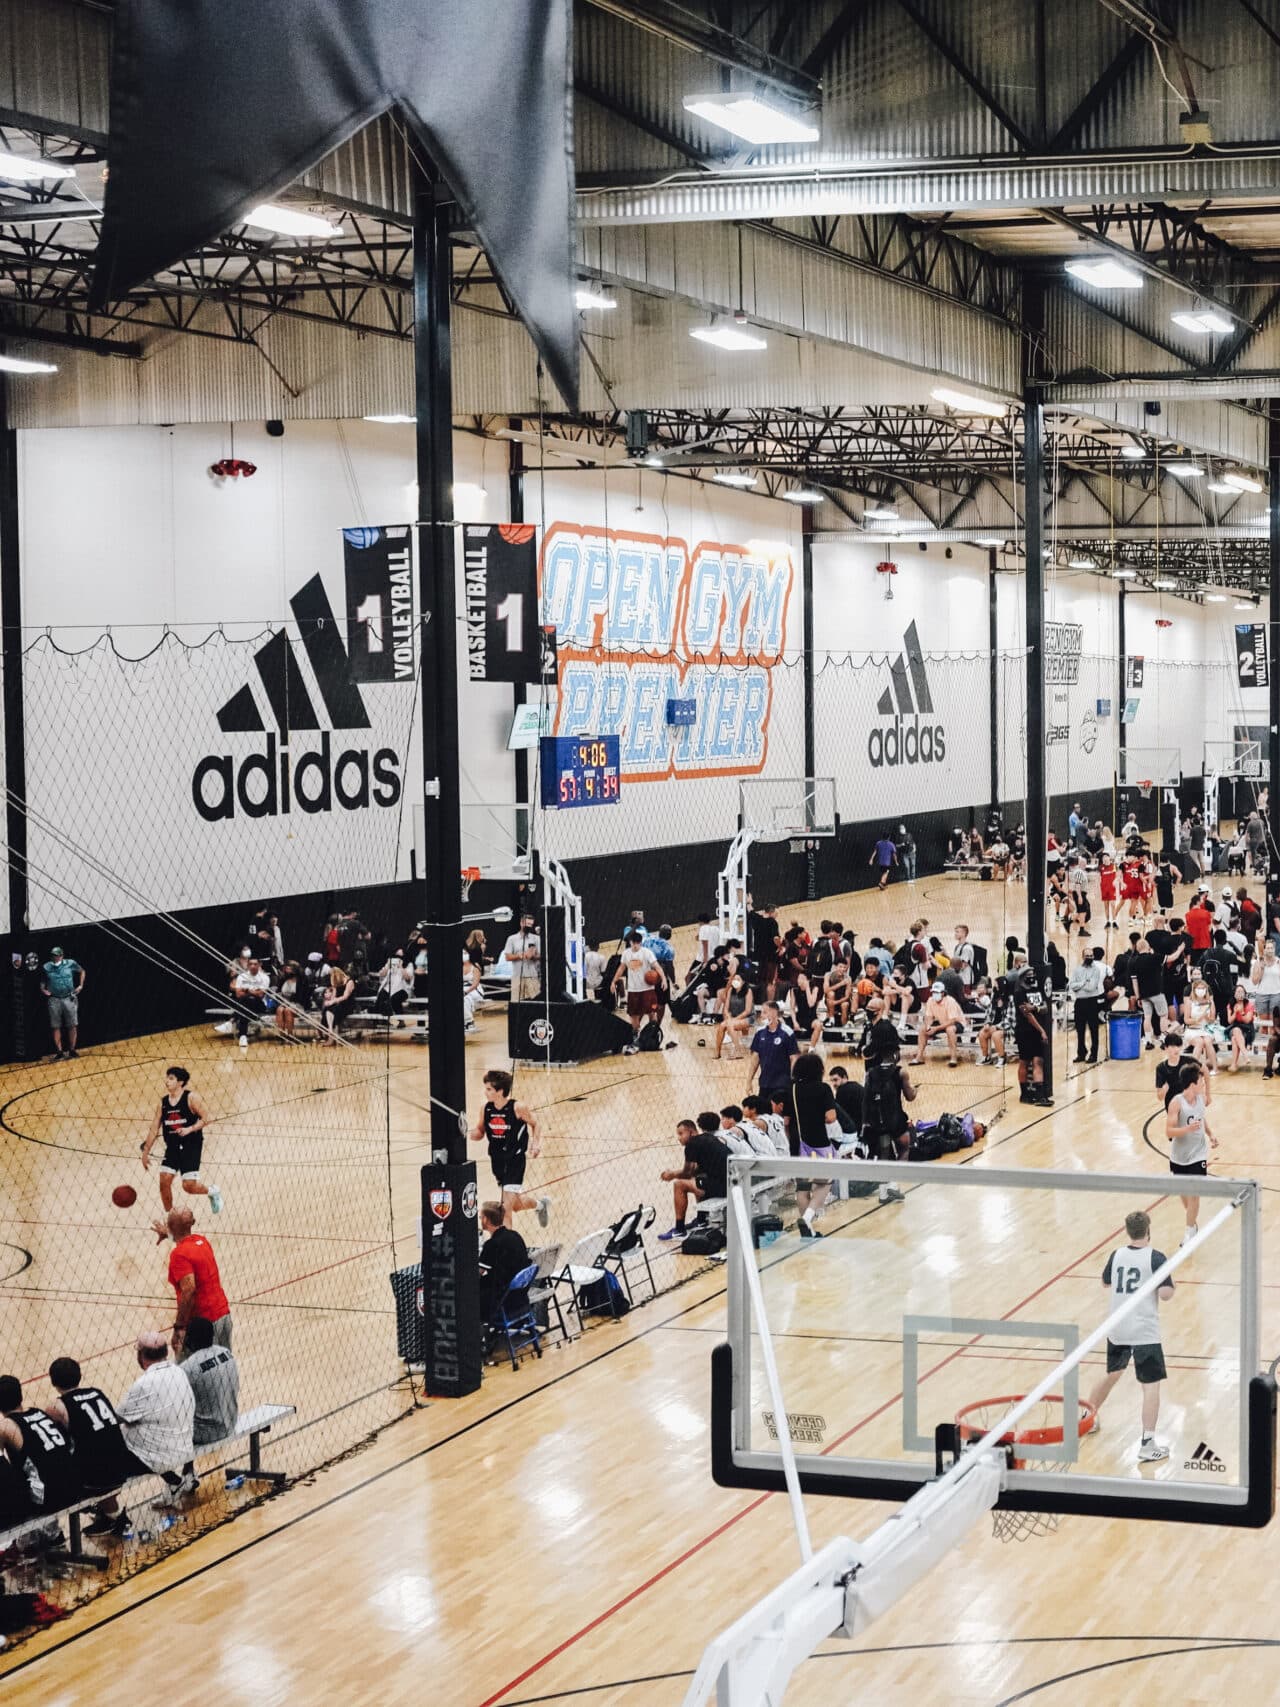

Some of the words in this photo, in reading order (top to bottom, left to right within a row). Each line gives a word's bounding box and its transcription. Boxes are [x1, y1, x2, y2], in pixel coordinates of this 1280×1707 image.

[545, 541, 684, 643] OPEN
[690, 558, 786, 650] GYM
[357, 595, 383, 652] 1
[388, 548, 414, 679] VOLLEYBALL
[466, 547, 487, 678] BASKETBALL
[496, 593, 523, 651] 1
[1044, 658, 1079, 681] REMIER
[1239, 651, 1254, 676] 2
[1254, 632, 1267, 686] VOLLEYBALL
[1134, 669, 1142, 683] 3
[562, 669, 767, 762] PREMIER
[580, 743, 607, 766] 4:06
[868, 714, 945, 767] adidas
[192, 731, 400, 822] adidas
[560, 778, 576, 801] 57
[586, 778, 594, 797] 4
[604, 775, 618, 797] 39
[1116, 1267, 1141, 1294] 12
[80, 1399, 118, 1432] 14
[30, 1419, 66, 1452] 15
